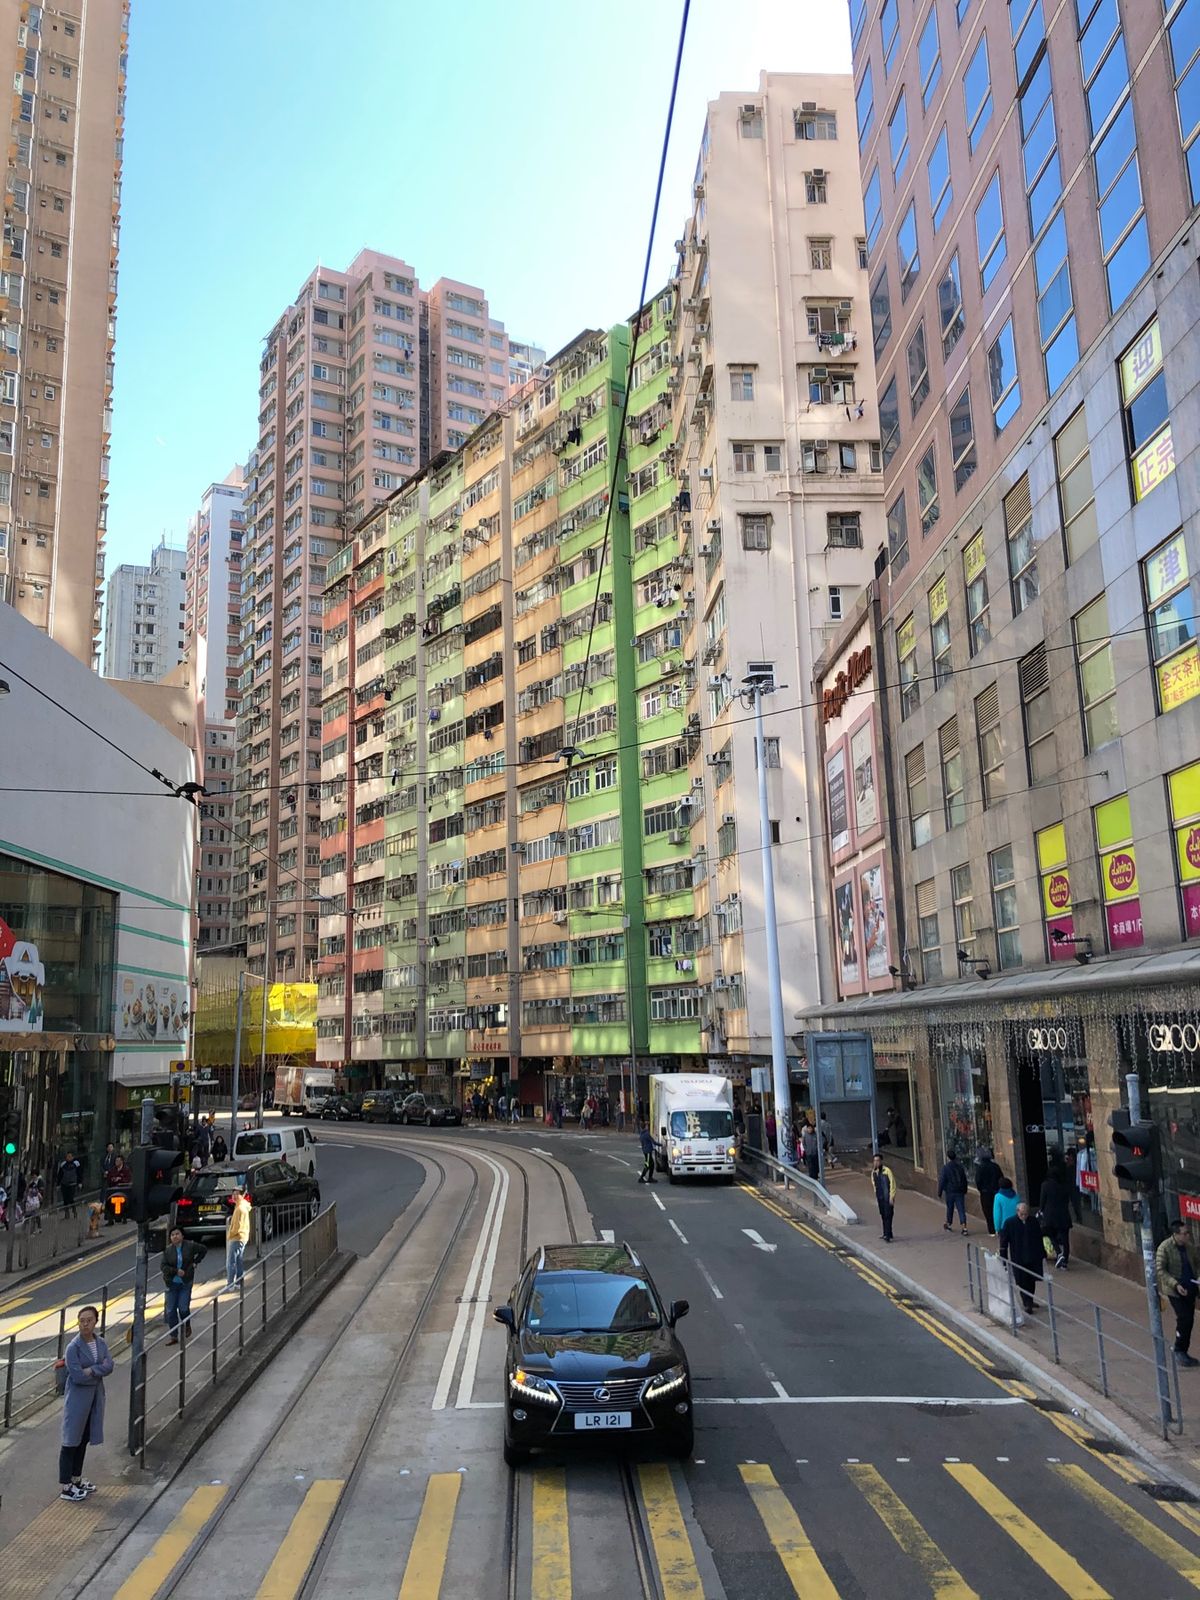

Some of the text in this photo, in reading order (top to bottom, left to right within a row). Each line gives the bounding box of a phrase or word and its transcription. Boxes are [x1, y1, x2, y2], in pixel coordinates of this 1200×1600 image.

[1027, 1027, 1067, 1051] G2000
[1149, 1023, 1200, 1052] G200
[1085, 1174, 1097, 1187] SALE
[586, 1415, 620, 1425] LR 121
